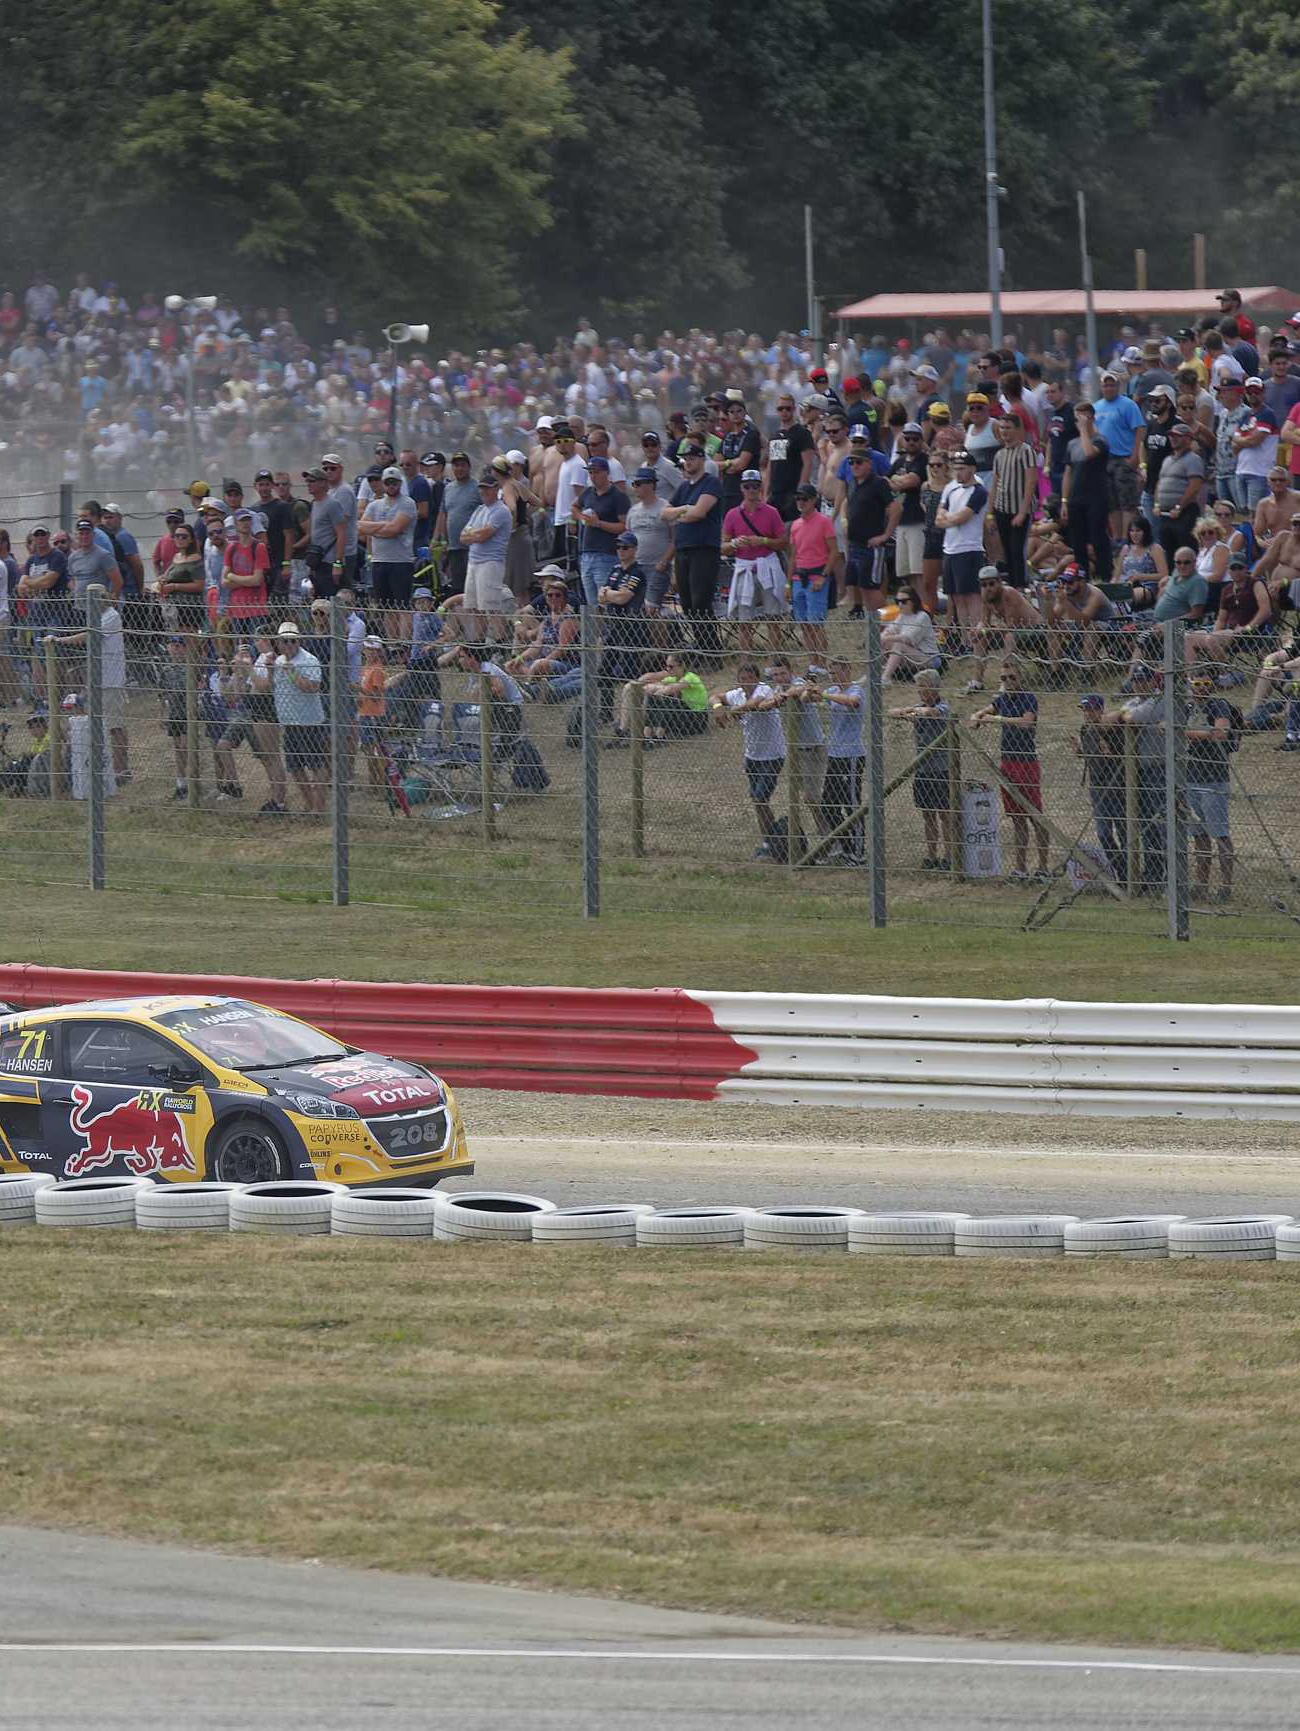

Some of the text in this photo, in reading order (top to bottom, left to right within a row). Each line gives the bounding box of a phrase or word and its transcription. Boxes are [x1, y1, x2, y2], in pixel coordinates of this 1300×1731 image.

[199, 1010, 255, 1026] HANSEN
[17, 1030, 47, 1059] 71
[6, 1058, 53, 1072] HANSEN
[221, 1056, 244, 1066] 71
[362, 1085, 431, 1106] TOTAL
[163, 1102, 192, 1110] RALLYCROSS
[308, 1123, 360, 1134] PAPYRUS
[390, 1122, 438, 1149] 208
[18, 1151, 53, 1160] TOTAL
